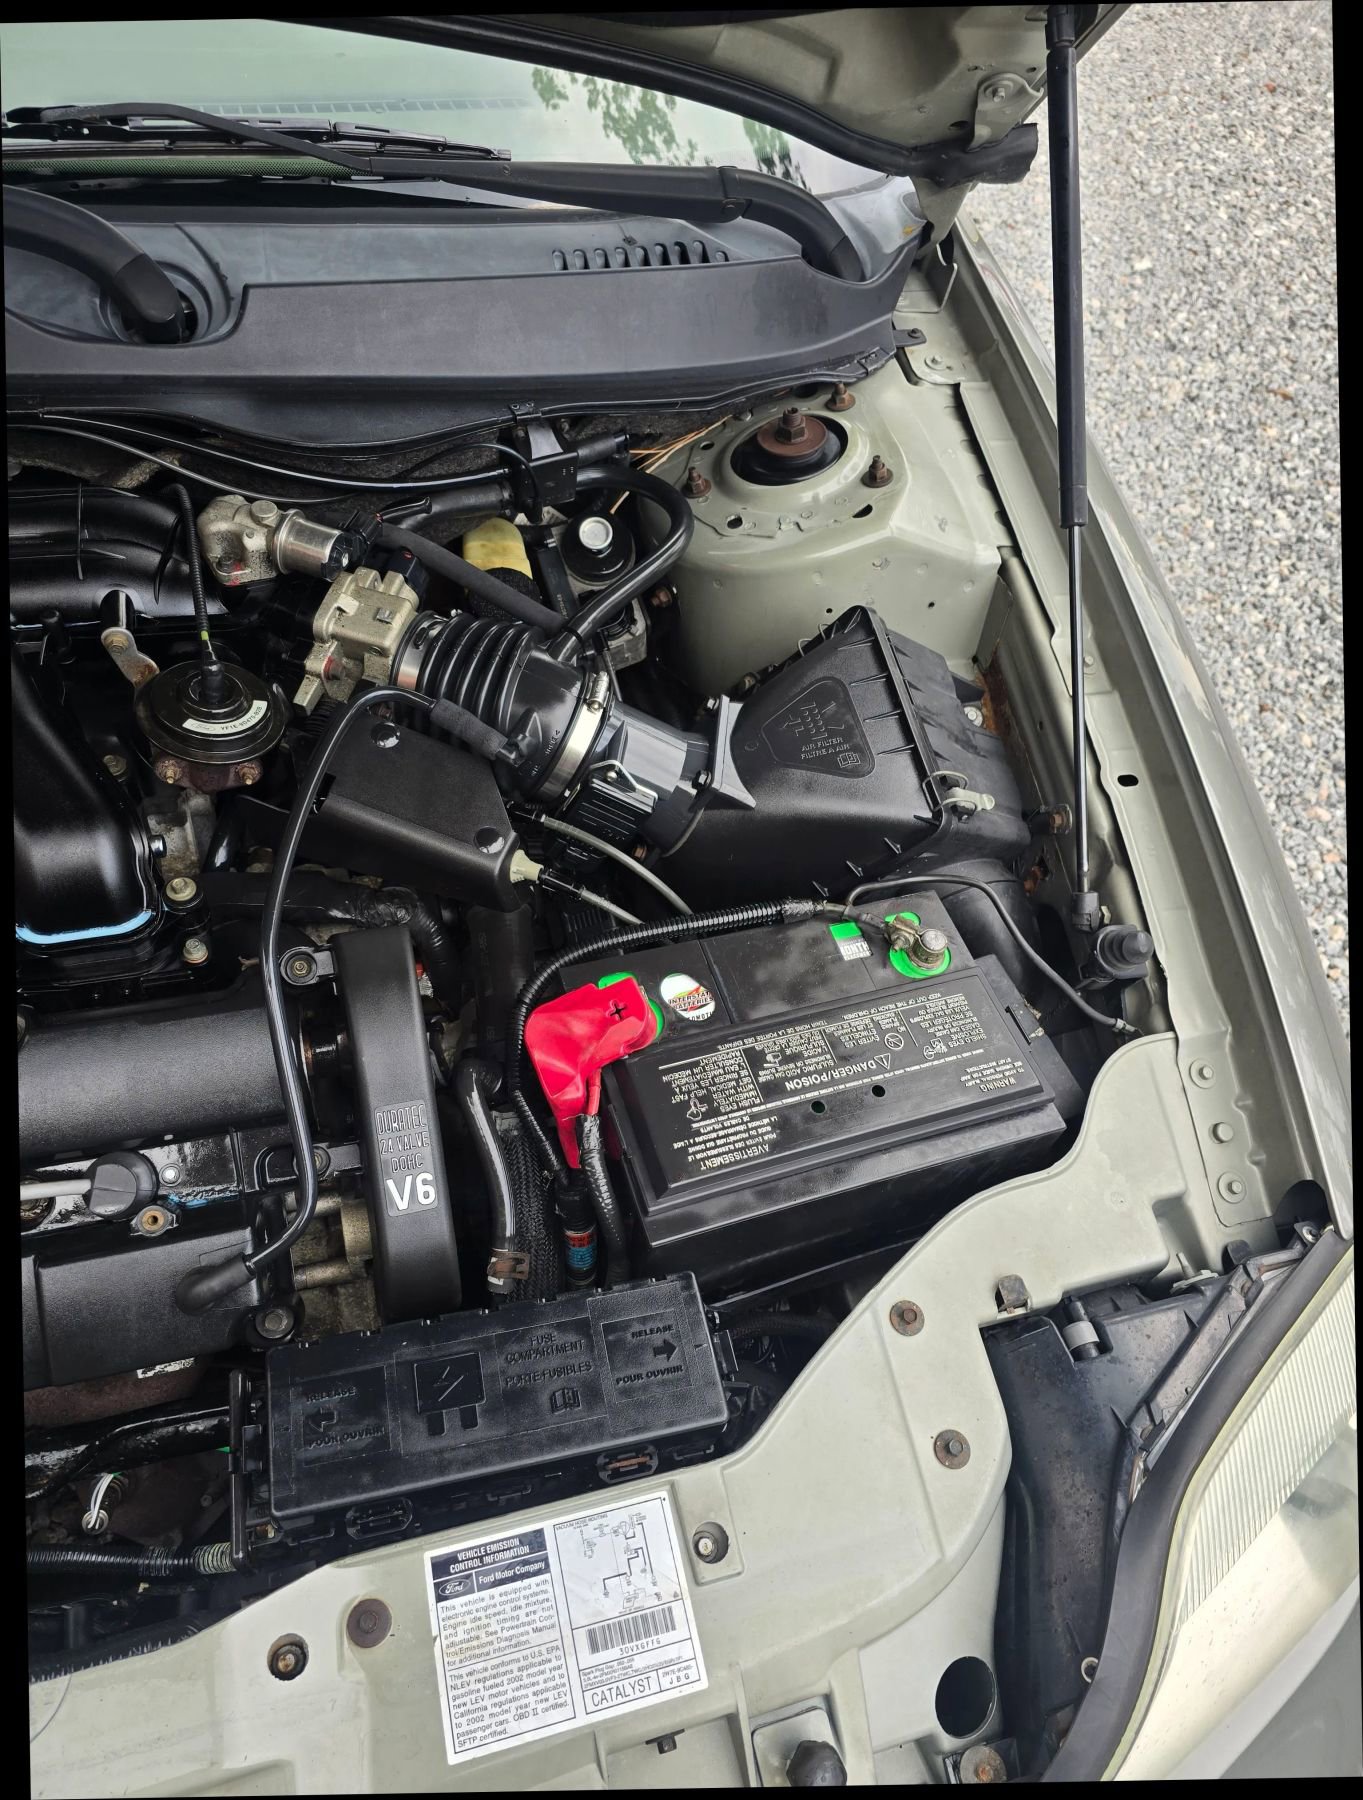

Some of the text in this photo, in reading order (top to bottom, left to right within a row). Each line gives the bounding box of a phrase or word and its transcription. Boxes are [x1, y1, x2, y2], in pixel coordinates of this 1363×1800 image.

[817, 737, 843, 747] FILTER
[668, 990, 711, 1005] INTERSTAT
[948, 1039, 965, 1048] EYES
[701, 1056, 743, 1071] CONSULTER
[739, 1069, 749, 1077] SE
[785, 1067, 801, 1077] ACID
[802, 1059, 834, 1073] SULFURIC
[679, 1081, 699, 1091] YEUX
[700, 1077, 713, 1087] LES
[714, 1072, 738, 1083] RINCER
[784, 1060, 877, 1091] DANGER/POISON
[979, 1076, 1017, 1093] WARNING
[671, 1077, 752, 1103] GET MEDICAL HELP FAST
[712, 1083, 755, 1099] WITH WATER
[714, 1090, 757, 1106] IMMEDIATELY
[720, 1102, 737, 1113] EYES
[738, 1097, 760, 1108] FLUSH
[376, 1104, 427, 1135] DURATEC
[380, 1131, 430, 1155] 24 VALVE
[391, 1153, 424, 1173] DOHC
[699, 1144, 769, 1170] AVERTISSEMENT
[386, 1172, 436, 1211] V6
[530, 1333, 557, 1346] FUSE
[631, 1324, 674, 1339] RELEASE
[505, 1340, 585, 1364] COMPARTMENT
[616, 1364, 683, 1385] POUR OUVRIR
[450, 1545, 529, 1573] CONTROL INFORMATION
[457, 1538, 519, 1561] VEHICLE EMISSION
[479, 1561, 545, 1584] Ford Motor Company
[441, 1605, 456, 1614] This
[460, 1596, 485, 1608] vehicle
[499, 1583, 532, 1598] equipped
[535, 1579, 549, 1587] with
[441, 1609, 473, 1623] electronic
[475, 1603, 497, 1613] engine
[498, 1595, 520, 1607] control
[443, 1620, 467, 1631] Engine
[470, 1616, 482, 1624] idle
[444, 1604, 553, 1640] and ignition timing are not
[485, 1630, 498, 1638] See
[500, 1619, 537, 1634] Powertrain
[496, 1630, 530, 1644] Diagnosis
[532, 1623, 556, 1634] Manual
[449, 1673, 464, 1682] This
[465, 1666, 489, 1678] vehicle
[490, 1657, 521, 1671] conforms
[530, 1649, 545, 1659] U.S.
[546, 1645, 560, 1655] EPA
[459, 1649, 491, 1664] additional
[450, 1679, 471, 1691] NLEV
[474, 1669, 514, 1685] regulations
[517, 1657, 552, 1673] applicable
[451, 1663, 563, 1703] gasoline fueled 2002 model year
[453, 1701, 467, 1710] new
[470, 1694, 485, 1705] LEV
[488, 1689, 508, 1700] motor
[511, 1680, 540, 1693] vehicles
[543, 1674, 556, 1684] and
[454, 1682, 566, 1720] California regulations applicable
[591, 1676, 651, 1707] CATALYST
[466, 1714, 485, 1726] 2002
[488, 1706, 511, 1719] model
[515, 1702, 531, 1713] year
[534, 1696, 549, 1705] new
[553, 1689, 567, 1700] LEV
[456, 1722, 493, 1741] passenger
[513, 1710, 530, 1722] OBD
[531, 1707, 539, 1716] II
[458, 1727, 508, 1748] SFTP certified.
